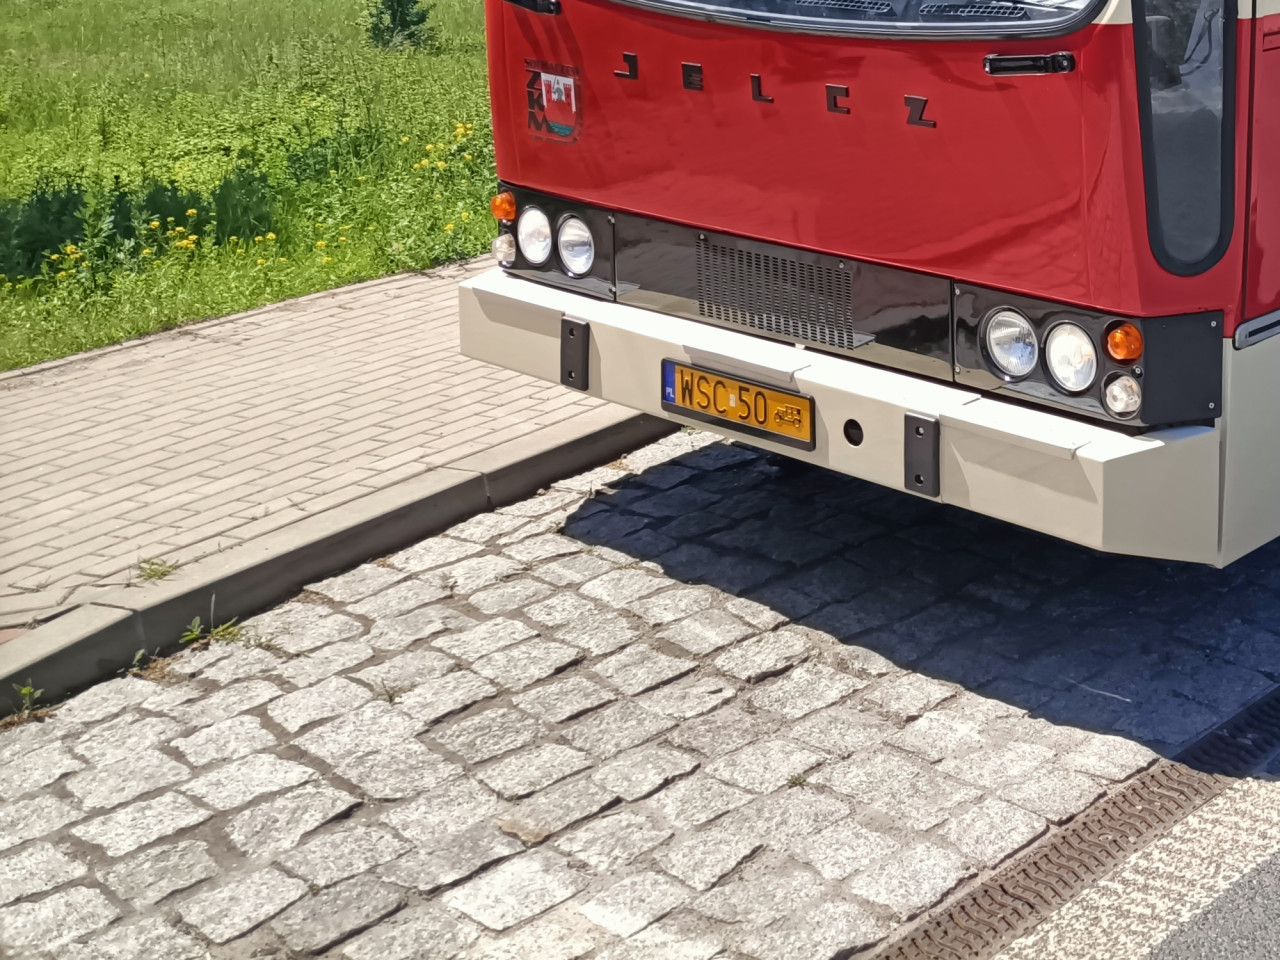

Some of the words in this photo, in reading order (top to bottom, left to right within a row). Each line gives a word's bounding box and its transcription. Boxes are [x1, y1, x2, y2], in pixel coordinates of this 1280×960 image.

[613, 52, 937, 128] JELCZ
[680, 369, 727, 414] WSC
[738, 385, 767, 425] 50
